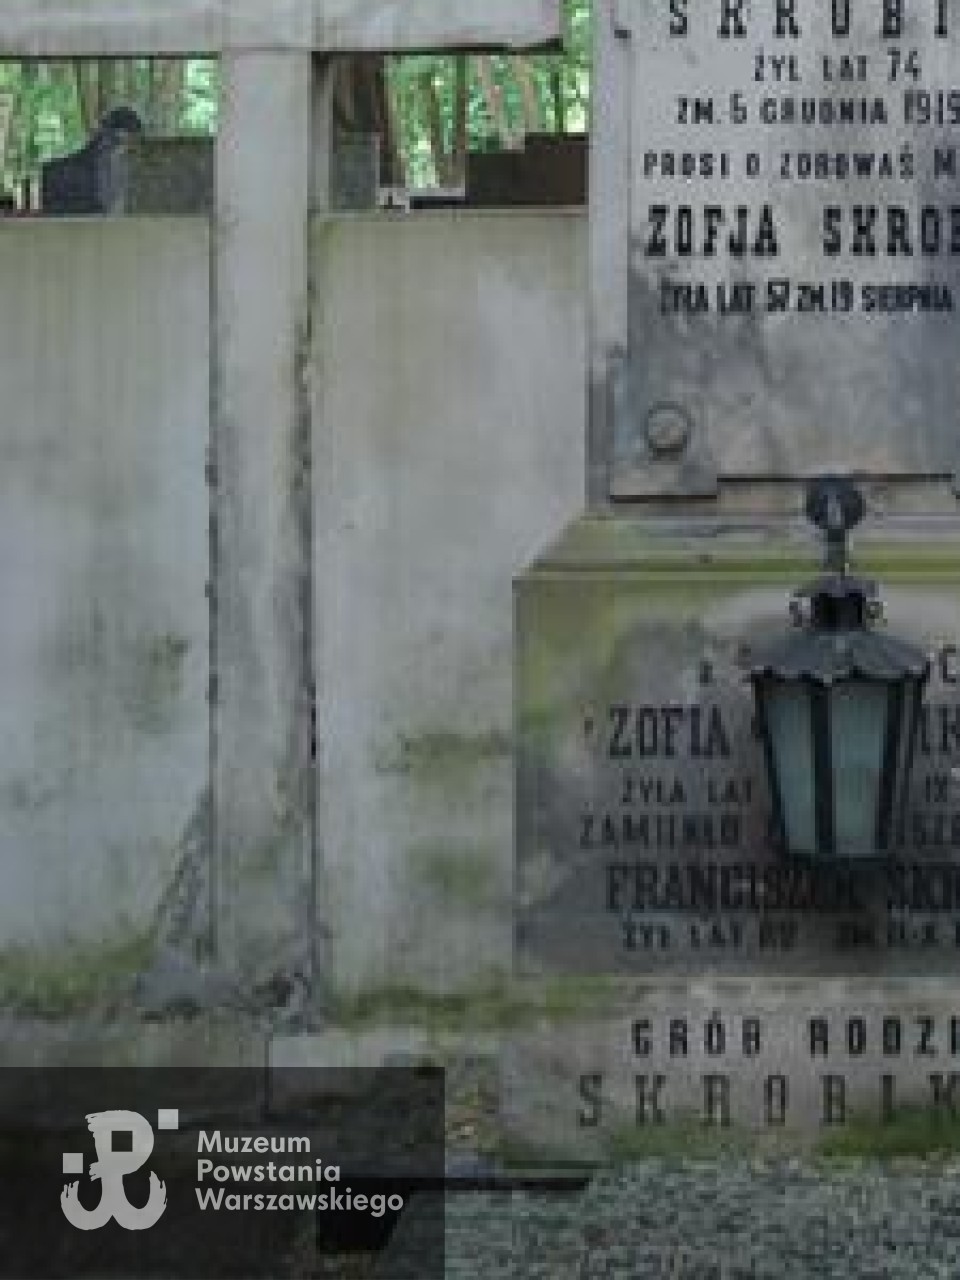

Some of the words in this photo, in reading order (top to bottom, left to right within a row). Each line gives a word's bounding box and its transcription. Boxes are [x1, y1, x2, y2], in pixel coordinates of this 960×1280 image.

[822, 53, 868, 82] LAT
[887, 46, 922, 82] 74
[760, 97, 888, 124] GRUDNIA
[644, 150, 730, 177] PROSI
[746, 152, 761, 177] O
[645, 204, 780, 256] ZOFJA
[608, 704, 732, 758] ZOFIA
[632, 1012, 761, 1058] GRÓB
